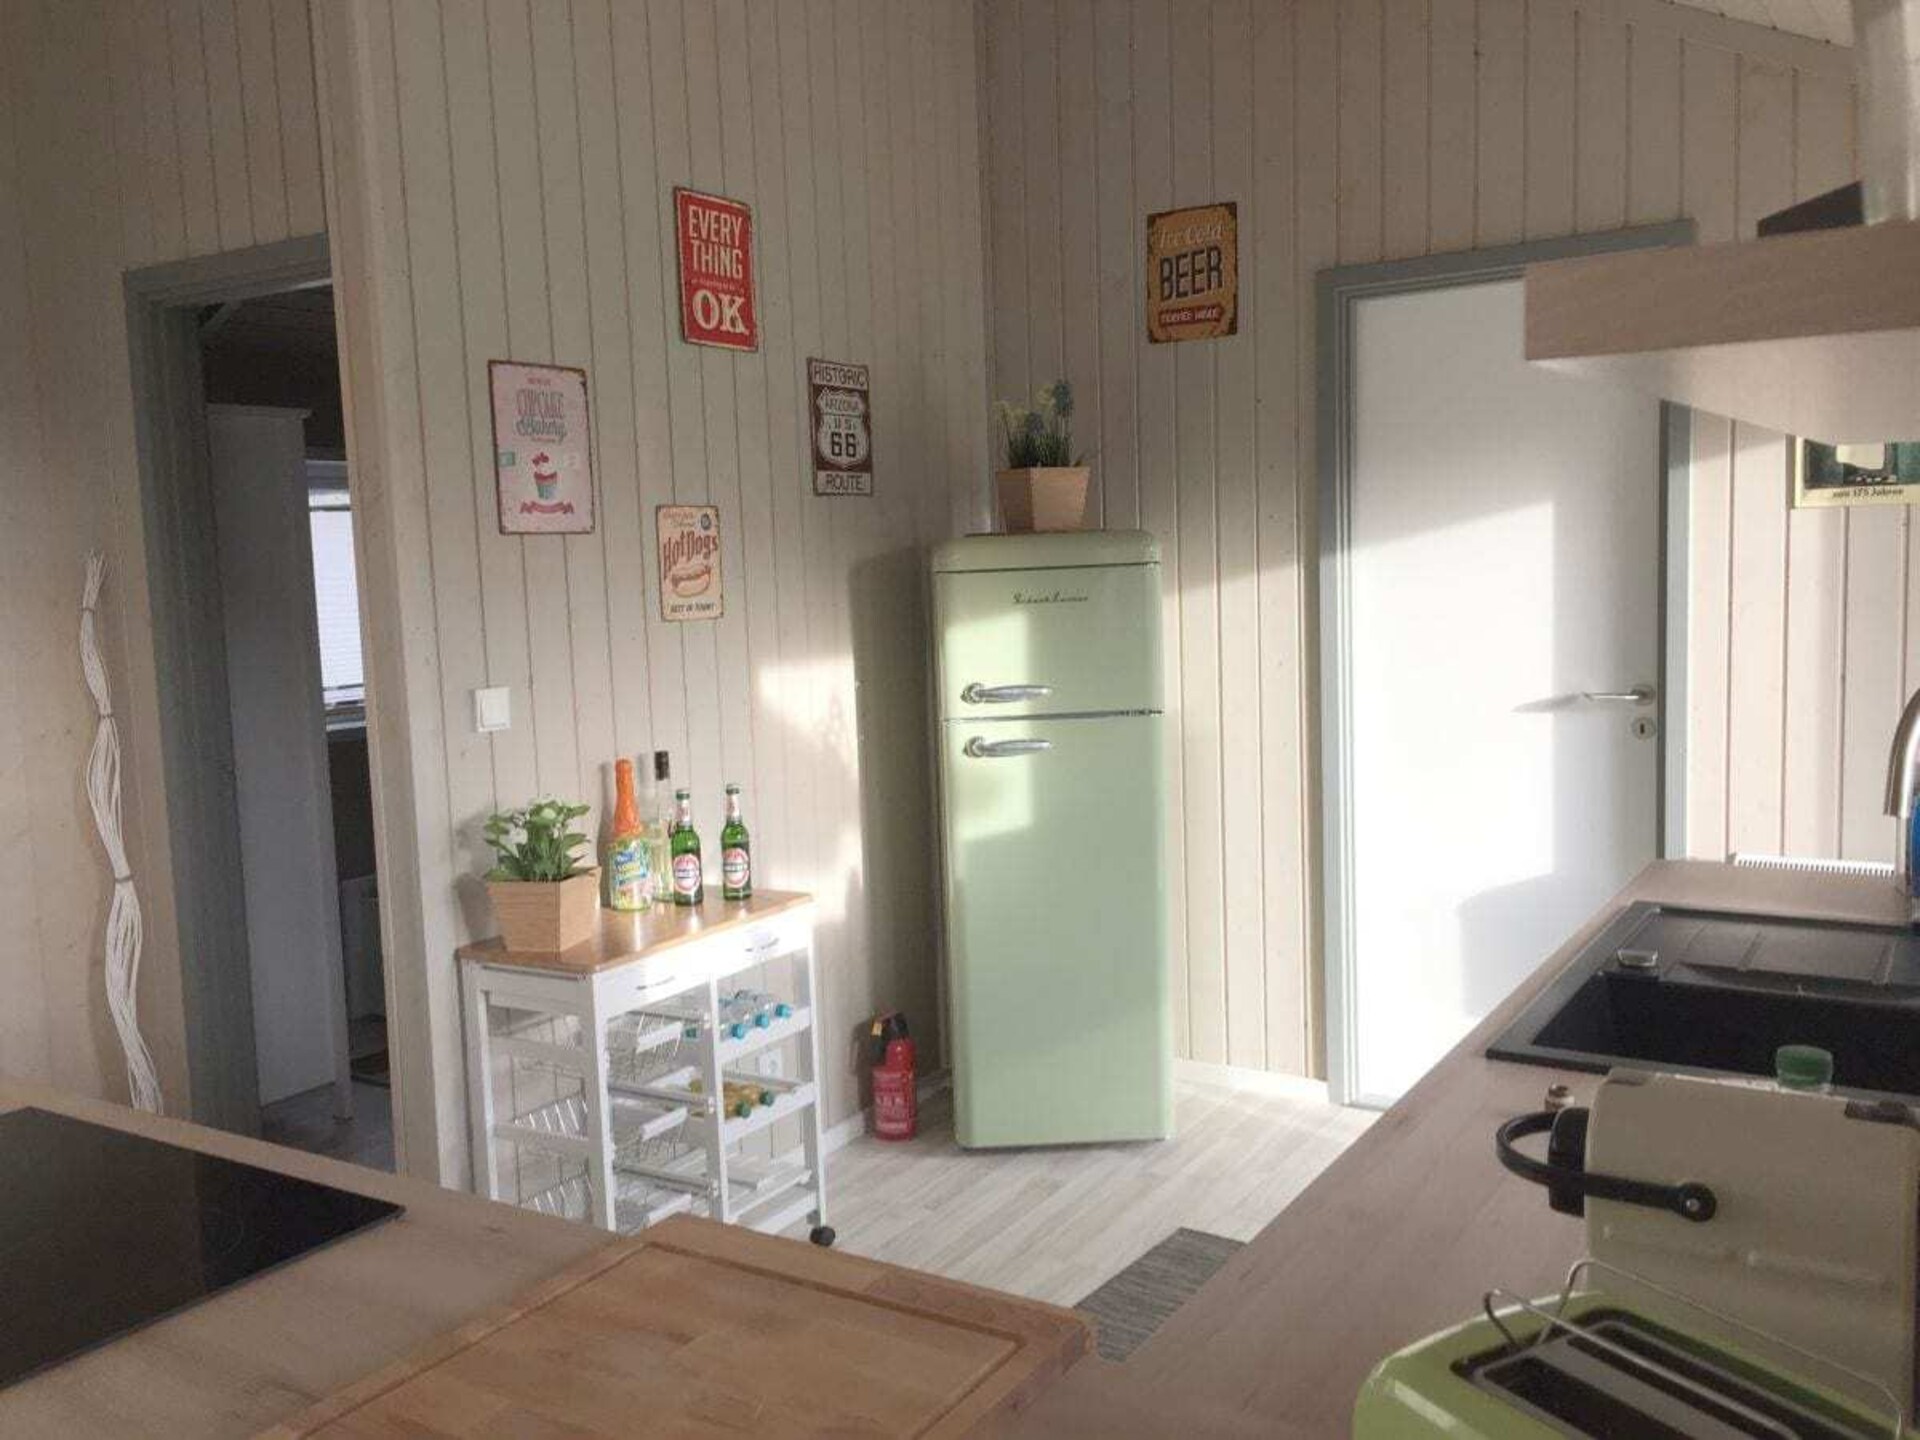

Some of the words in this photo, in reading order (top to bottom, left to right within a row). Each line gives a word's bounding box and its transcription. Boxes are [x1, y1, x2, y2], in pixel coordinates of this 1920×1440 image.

[689, 205, 743, 247] EVERY
[691, 239, 743, 279] THING
[1160, 245, 1223, 301] BEER
[692, 289, 750, 336] OK
[812, 365, 867, 387] HISTORIC
[830, 432, 857, 457] 66
[825, 473, 863, 491] ROUTE
[663, 530, 686, 582] Hot
[686, 530, 718, 562] Dogs
